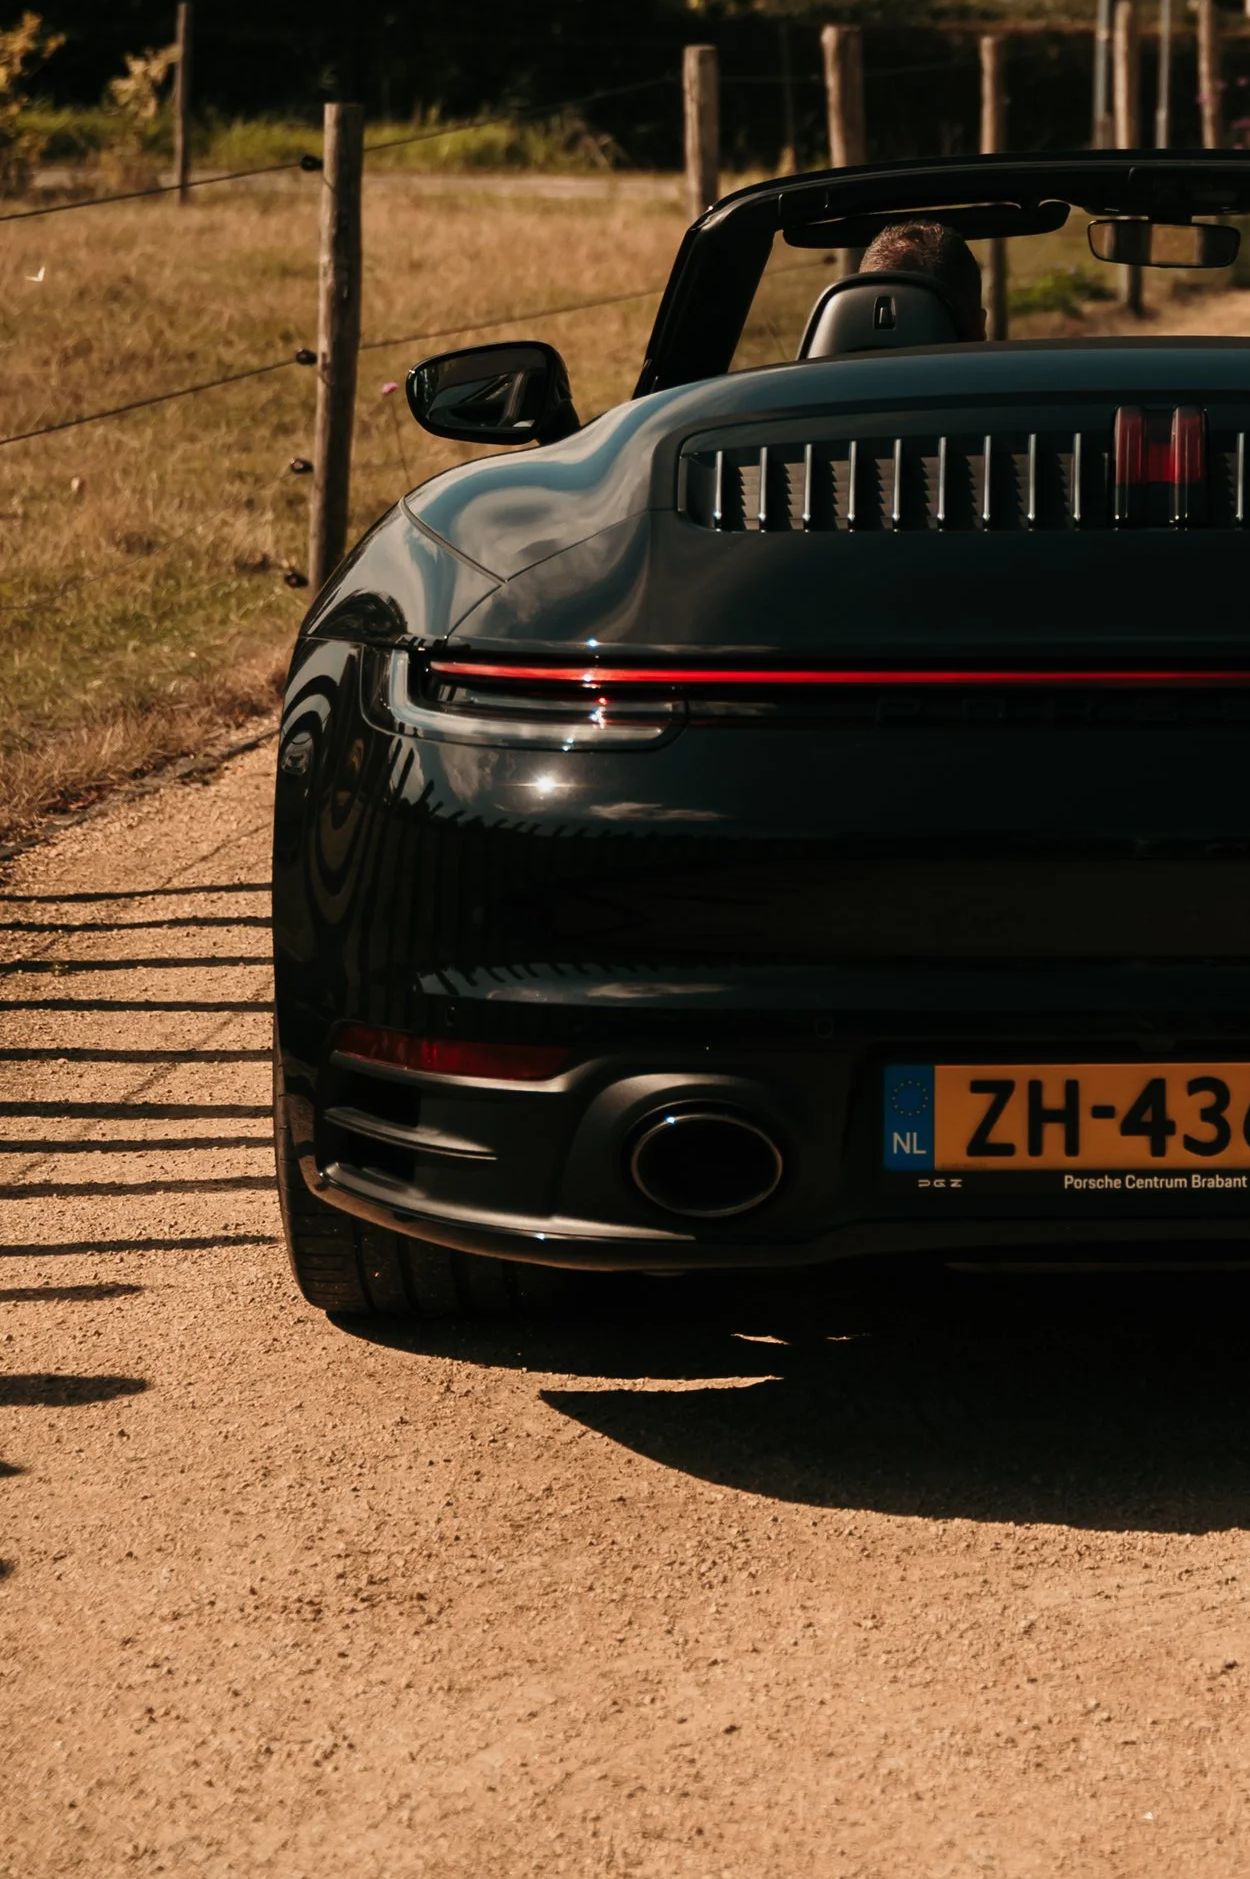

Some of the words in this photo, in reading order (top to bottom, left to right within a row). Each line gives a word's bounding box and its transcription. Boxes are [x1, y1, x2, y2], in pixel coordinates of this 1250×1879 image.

[892, 1131, 927, 1155] NL
[1064, 1174, 1122, 1190] Porsche
[1125, 1174, 1188, 1189] Centrum
[1191, 1173, 1248, 1189] Brabant
